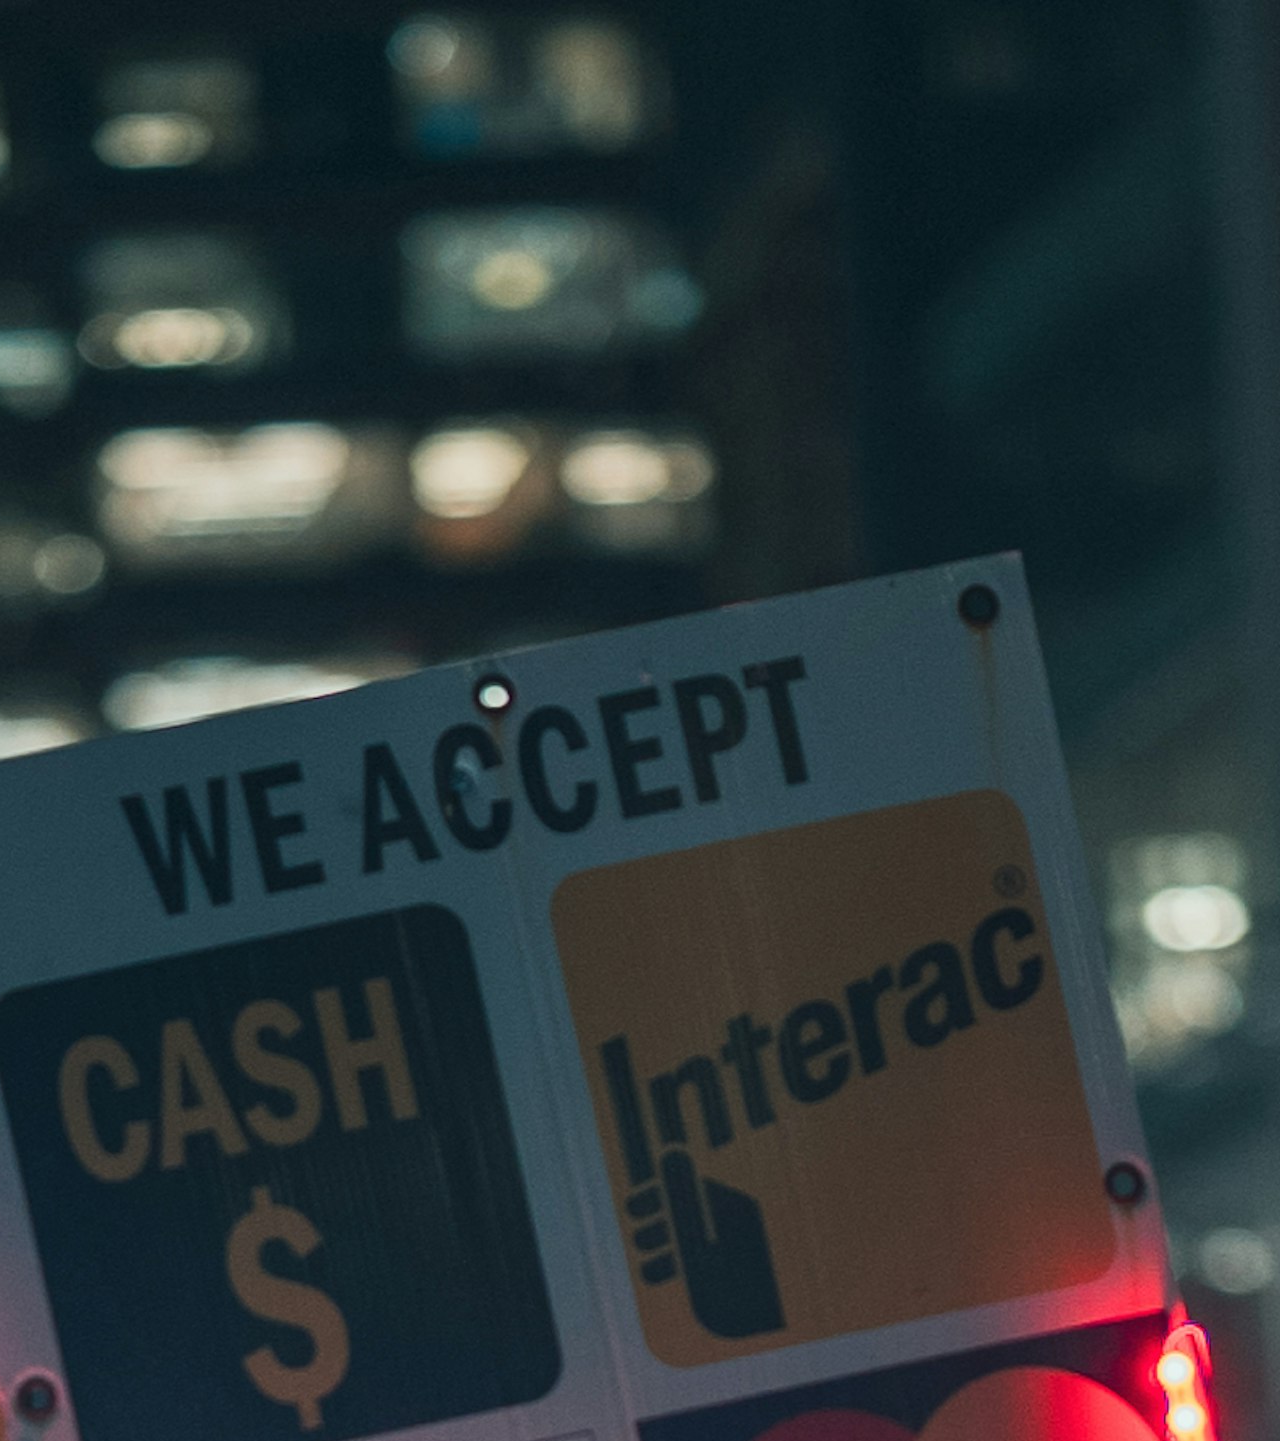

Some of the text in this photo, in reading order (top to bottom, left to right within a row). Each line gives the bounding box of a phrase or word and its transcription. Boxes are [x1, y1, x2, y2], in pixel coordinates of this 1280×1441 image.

[123, 655, 809, 916] WE ACCEPT
[60, 977, 421, 1184] CASH
[600, 903, 1047, 1183] Interac
[225, 1186, 350, 1431] $
